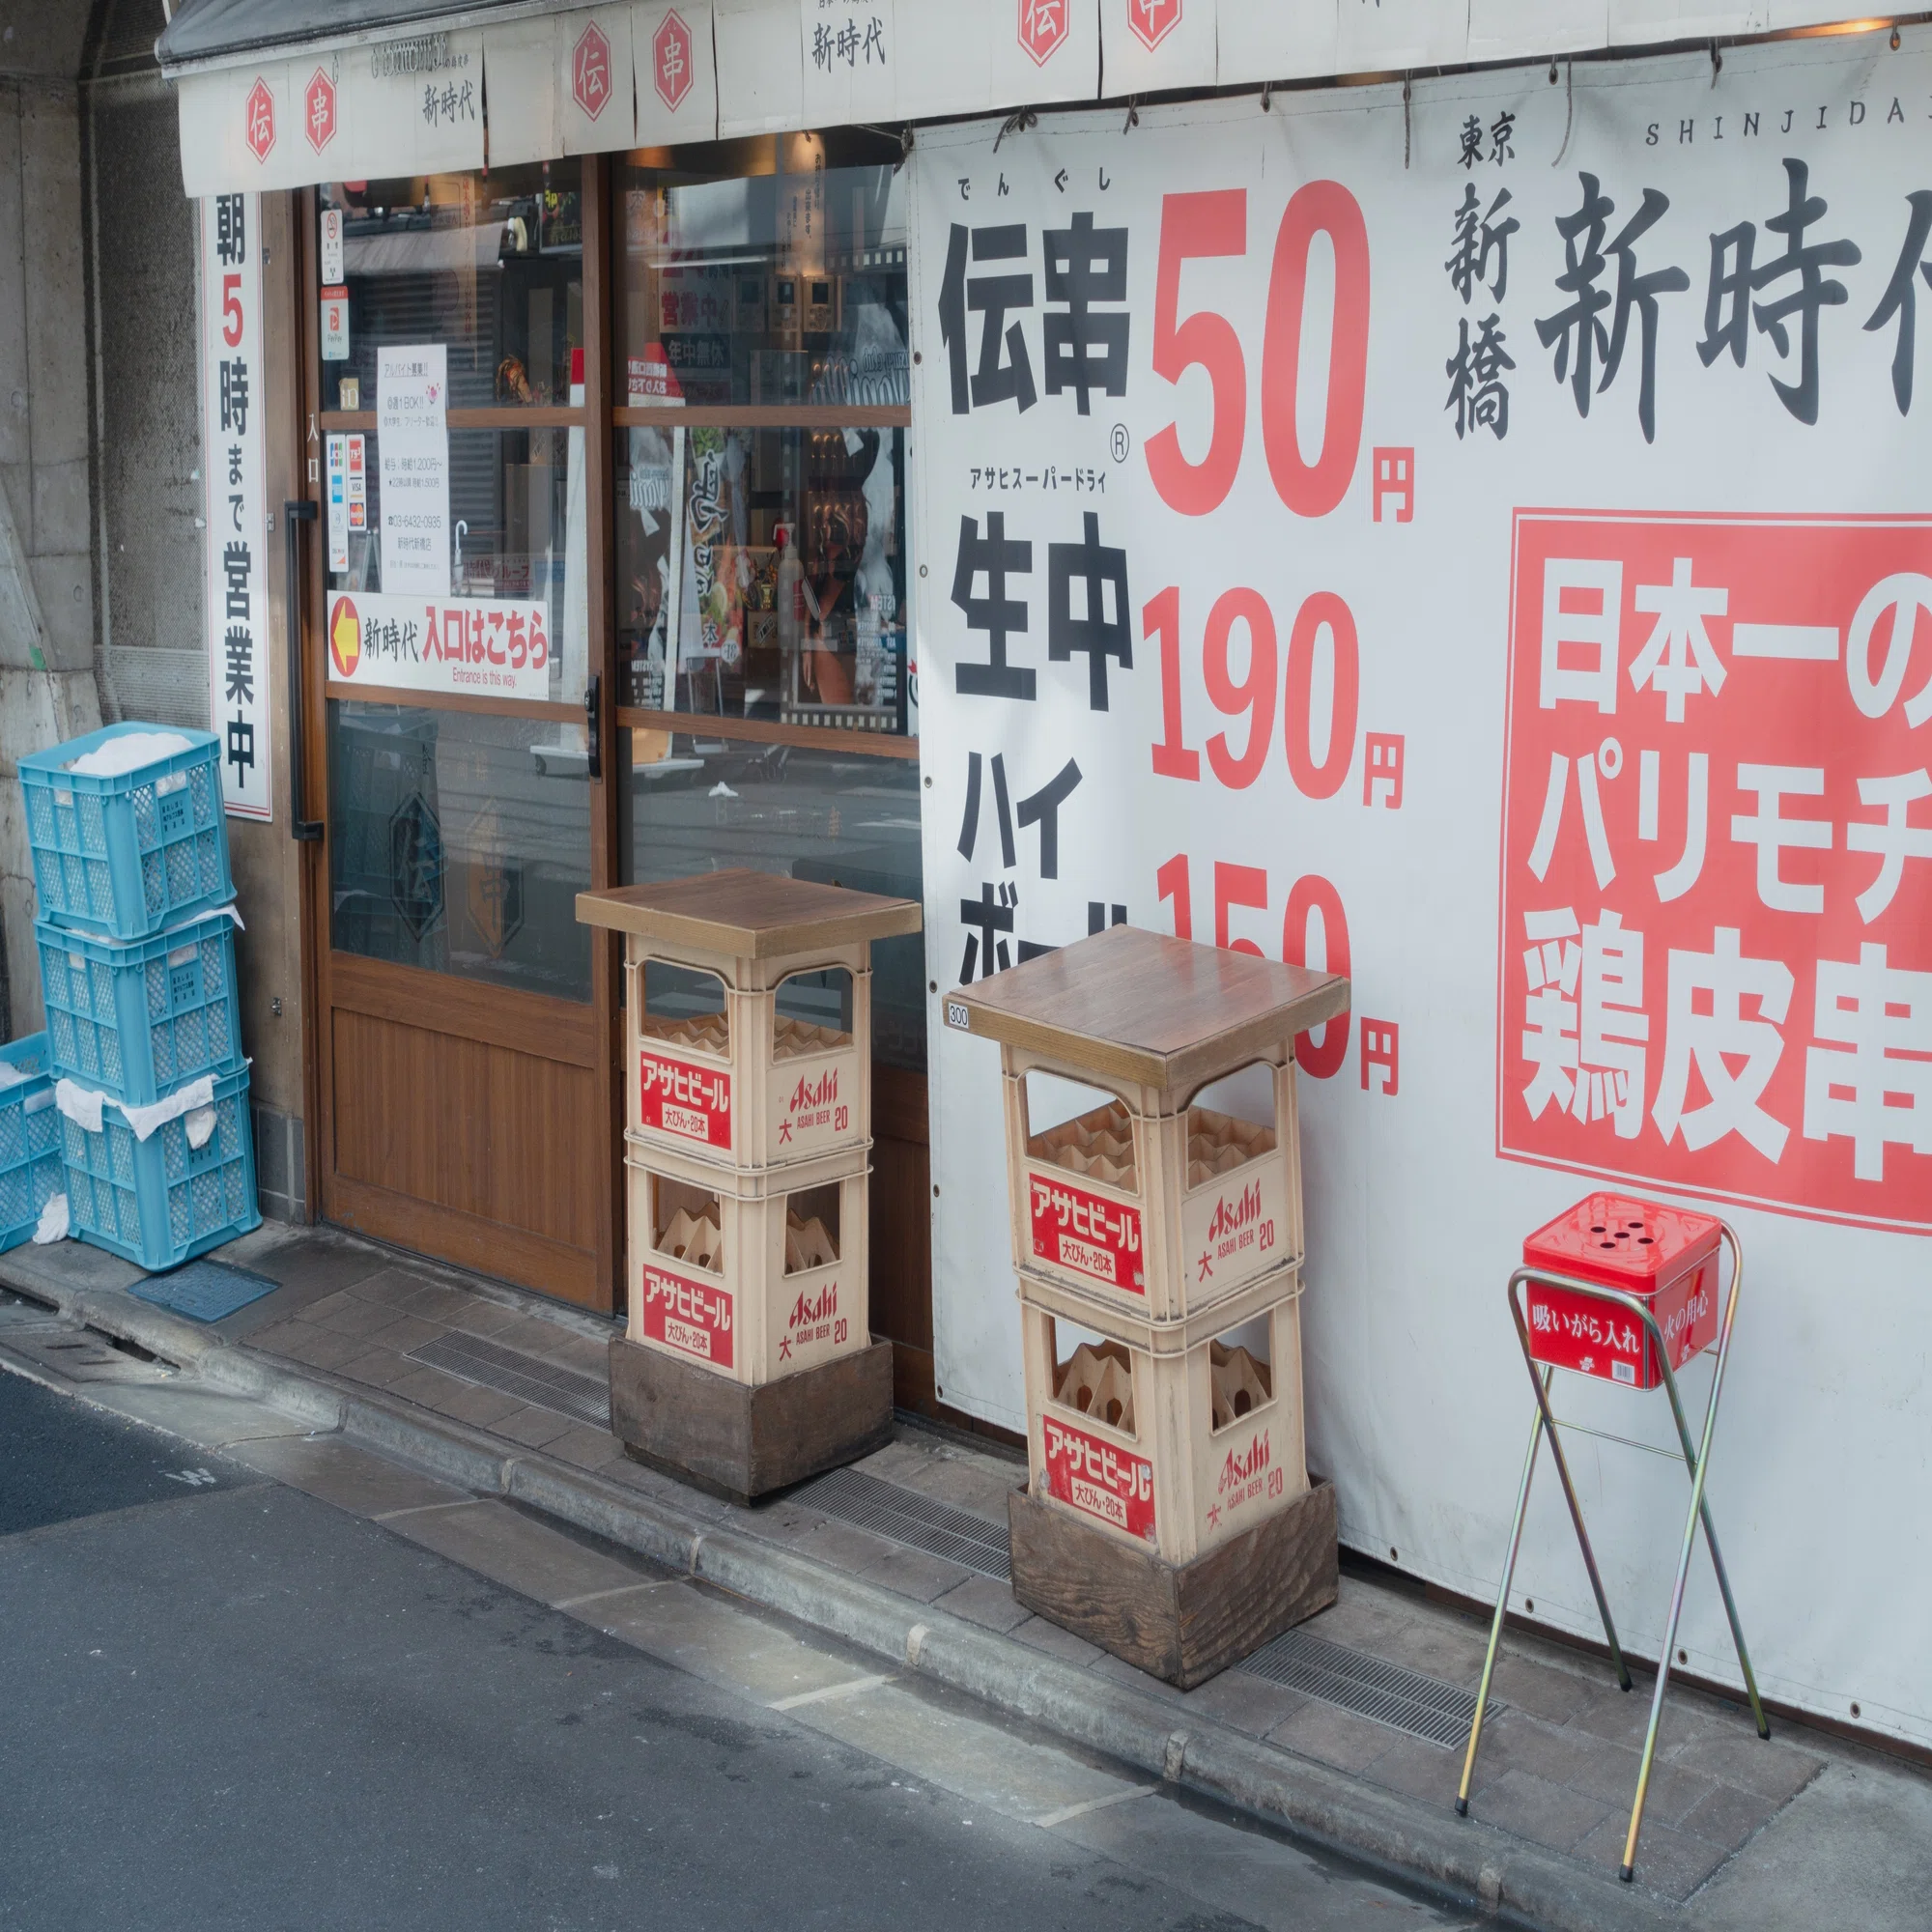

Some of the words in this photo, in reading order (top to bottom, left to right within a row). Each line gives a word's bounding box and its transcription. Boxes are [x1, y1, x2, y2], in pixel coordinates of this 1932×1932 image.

[663, 33, 684, 98] 串
[811, 16, 886, 73] 新時代
[579, 46, 606, 100] 伝
[250, 99, 271, 148] 伝
[422, 79, 475, 128] 新時代
[1645, 97, 1932, 147] SHINJIDA
[1458, 111, 1517, 170] 東京
[957, 166, 1111, 201] でんぐし
[939, 212, 1131, 416] 伝串
[1444, 182, 1520, 441] 新橋
[307, 413, 319, 483] 入口
[216, 193, 255, 788] 朝5時まで営業中
[352, 483, 361, 492] VISA
[969, 467, 1108, 495] アサヒスーパードライ
[393, 515, 441, 529] 03-6432-0935
[950, 511, 1134, 713] 生中
[364, 616, 419, 664] 新時代
[422, 606, 548, 669] 入口はこちら
[1539, 556, 1932, 730] 日本一の
[452, 667, 481, 684] Entrance
[482, 669, 488, 684] is
[489, 670, 501, 686] this
[502, 674, 517, 689] way.
[1527, 736, 1932, 924] パリモチ
[950, 1006, 968, 1026] 300
[1521, 906, 1932, 1183] 鶏皮串
[642, 1059, 729, 1113] アサヒビール
[789, 1067, 838, 1113] Asahi
[779, 1119, 792, 1145] 大
[797, 1114, 814, 1130] ASAHI
[816, 1109, 831, 1125] BEER
[835, 1105, 848, 1132] 20
[1034, 1182, 1139, 1252] アサヒビール
[1208, 1178, 1262, 1242] Asahi
[1217, 1238, 1237, 1261] ASAHI
[1237, 1232, 1255, 1250] BEER
[1259, 1219, 1274, 1252] 20
[1198, 1250, 1213, 1283] 大
[644, 1271, 731, 1332] アサヒビール
[788, 1281, 838, 1329] Asahi
[1663, 1290, 1709, 1343] 火の用心
[779, 1336, 792, 1362] 大
[795, 1330, 814, 1346] ASAHI
[815, 1323, 831, 1340] BEER
[834, 1318, 847, 1345] 20
[1532, 1304, 1640, 1353] 吸いがら入れ
[1046, 1424, 1151, 1501] アサヒビール
[1217, 1428, 1270, 1495] Asahi
[1267, 1467, 1283, 1499] 20
[1207, 1503, 1222, 1531] 大
[1227, 1490, 1246, 1512] ASAHI
[1247, 1476, 1264, 1500] BEER
